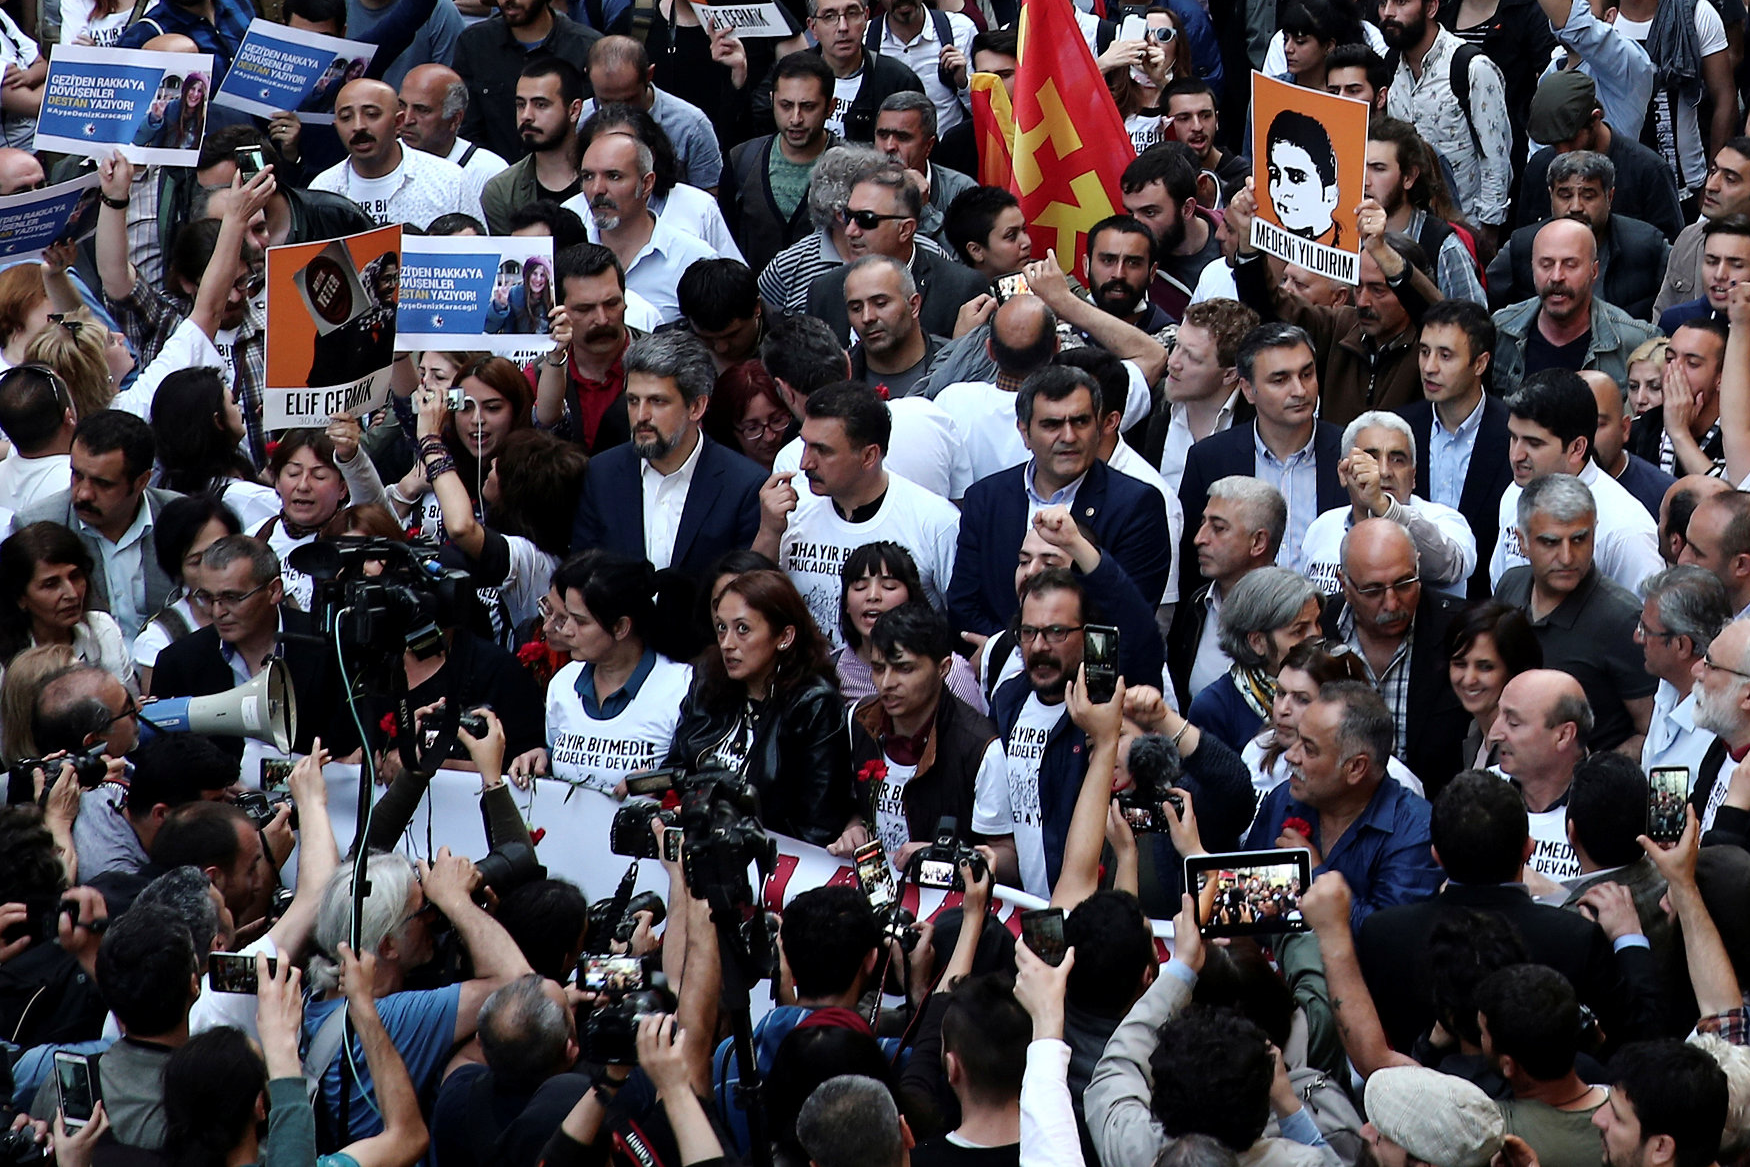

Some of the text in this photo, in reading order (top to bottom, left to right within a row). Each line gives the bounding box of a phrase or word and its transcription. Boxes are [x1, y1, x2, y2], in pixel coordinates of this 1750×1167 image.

[240, 52, 294, 73] DÖVÜŞENLER
[244, 42, 319, 69] GEZİ'DEN RAKKA'YA
[52, 74, 145, 91] GEZİ'DEN RAKKA'YA
[237, 61, 307, 85] DESTAN YAZIYOR!
[49, 85, 115, 99] DÖVÜŞENLER
[47, 96, 134, 111] DESTAN YAZIYOR!
[1255, 221, 1354, 281] MEDENİ YILDIRIM
[433, 267, 483, 279] RAKKA'YA
[430, 290, 477, 301] YAZIYOR!
[286, 392, 320, 416] ELİF
[298, 417, 310, 425] 30
[798, 542, 839, 561] HAYIR
[400, 699, 409, 730] SONY
[587, 734, 645, 756] BİTMEDİ
[605, 756, 655, 770] DEVAM!
